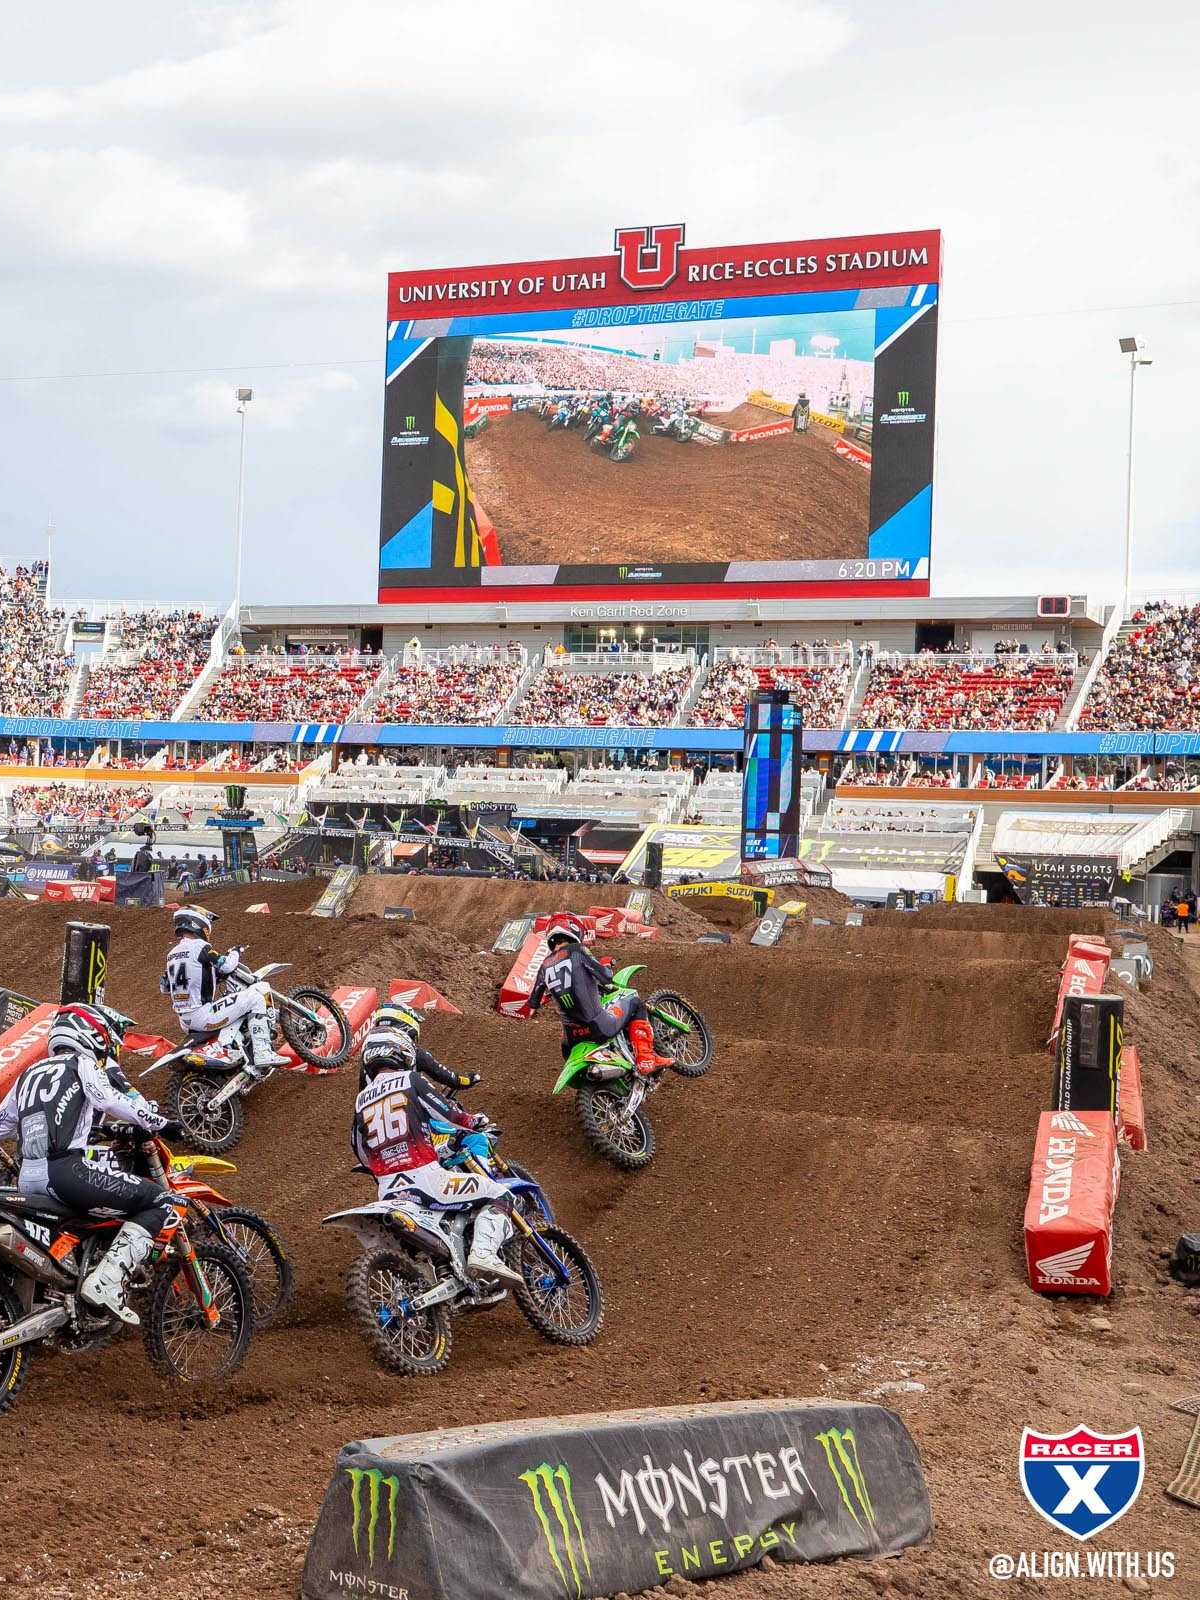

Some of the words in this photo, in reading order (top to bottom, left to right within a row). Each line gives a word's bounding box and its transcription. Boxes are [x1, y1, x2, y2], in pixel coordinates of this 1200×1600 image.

[614, 223, 686, 291] U
[688, 255, 818, 283] RICE-ECCLES
[825, 247, 929, 272] STADIUM
[399, 278, 513, 304] UNIVERSITY
[518, 276, 545, 296] OF
[552, 271, 607, 293] UTAH
[571, 299, 725, 329] #DROPTHEGATE
[477, 403, 510, 414] HONDA
[749, 425, 791, 441] HONDA
[837, 561, 877, 579] 6:20
[880, 560, 911, 578] PM
[570, 606, 594, 617] Ken
[597, 606, 625, 618] Garff
[629, 605, 653, 617] Red
[657, 605, 688, 617] Zone
[991, 623, 1033, 632] CONCESSIONS
[2, 718, 142, 740] #DROPTHEGATE
[502, 728, 656, 747] #DROPTHEGATE
[470, 802, 518, 812] MONSTER
[67, 834, 91, 842] UTAH
[36, 868, 69, 881] YAMAHA
[1034, 863, 1065, 873] UTAH
[1070, 864, 1112, 874] SPORTS
[198, 874, 234, 887] MONSTER
[670, 885, 714, 898] SUZUKI
[7, 1008, 22, 1019] MOTO
[216, 993, 239, 1014] FLY
[1064, 1018, 1073, 1095] CHAMPIONSHIP
[18, 1062, 66, 1113] 473
[356, 1075, 405, 1111] NICOLETTI
[54, 1081, 81, 1126] CANVAS
[361, 1092, 409, 1149] 36
[1039, 1136, 1076, 1226] HONDA
[23, 1218, 51, 1248] 473
[1037, 1275, 1102, 1286] HONDA
[7, 1352, 23, 1391] DUNLOP
[594, 1446, 823, 1537] MONSTER
[657, 1521, 798, 1577] ENERGY
[329, 1569, 409, 1600] MONSTER
